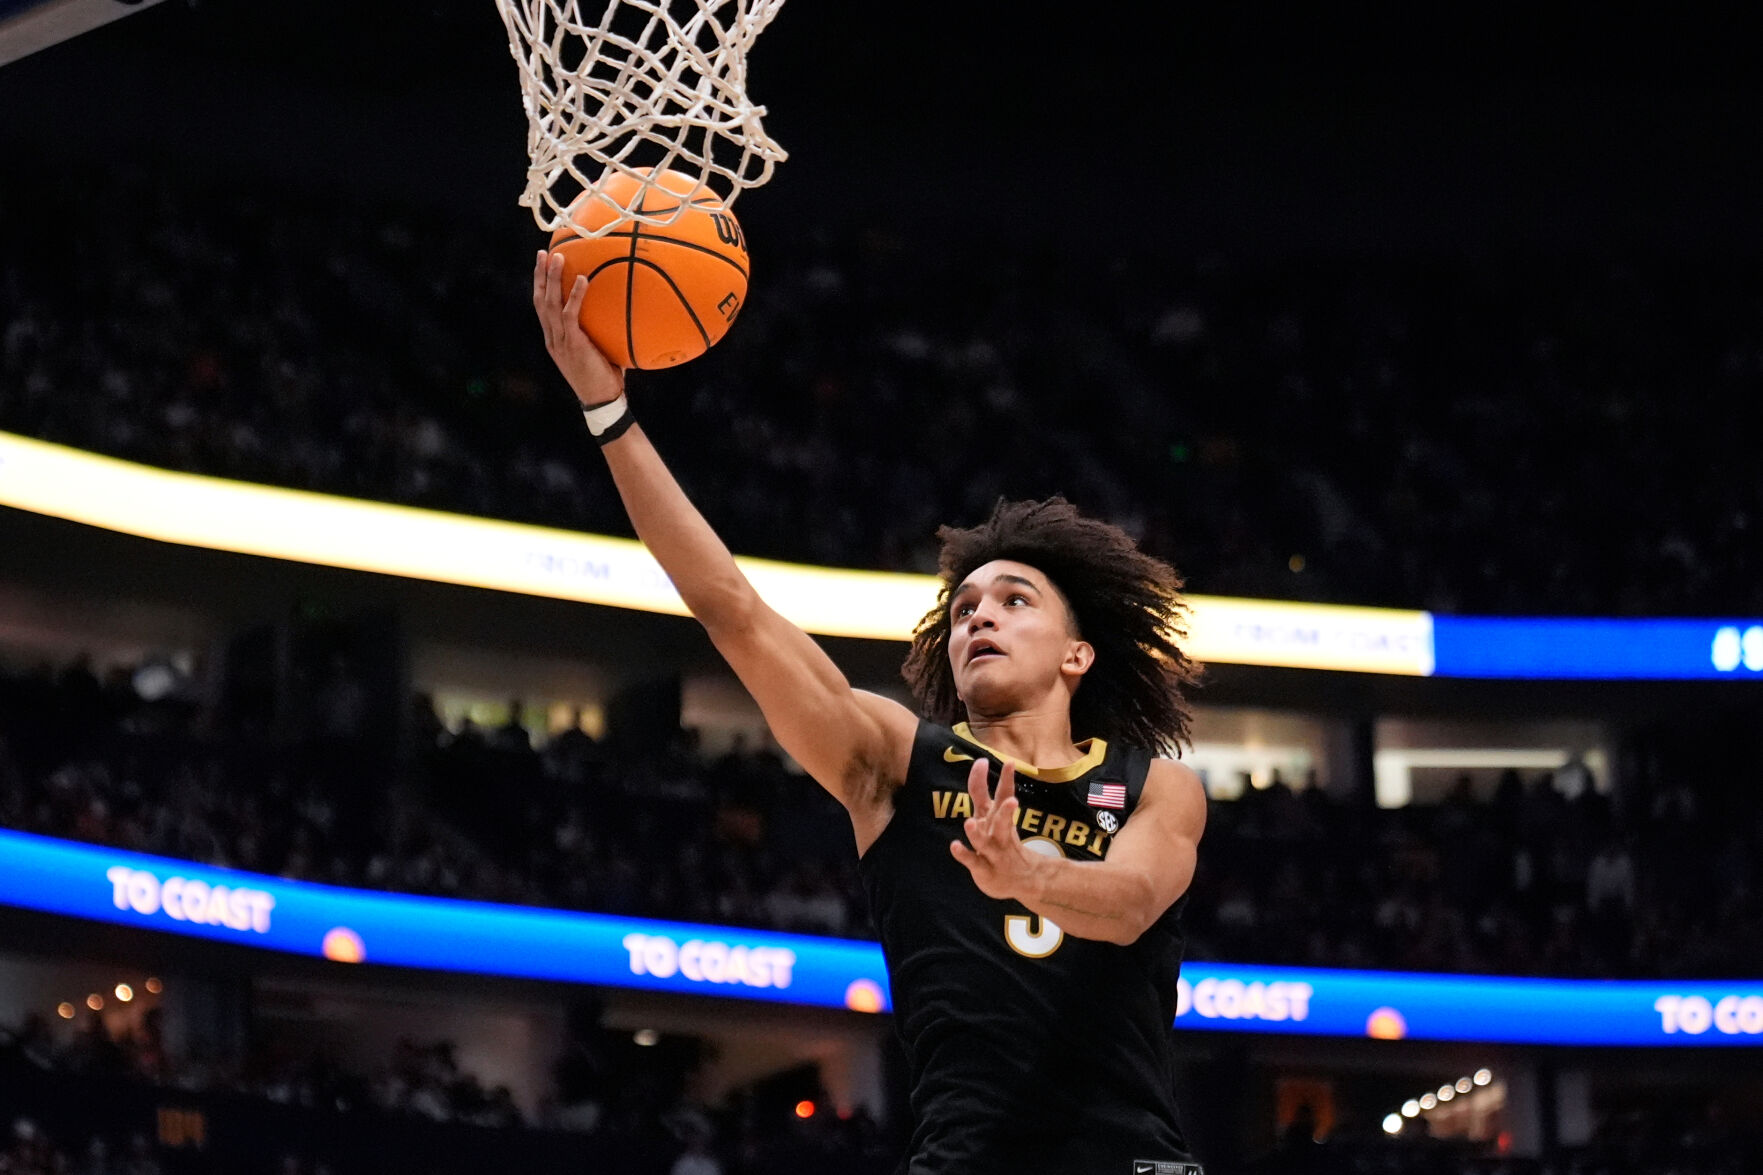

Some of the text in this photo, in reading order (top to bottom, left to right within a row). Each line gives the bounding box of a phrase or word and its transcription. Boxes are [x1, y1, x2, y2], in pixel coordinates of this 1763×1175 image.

[932, 791, 1108, 857] VAERBI
[106, 866, 276, 934] TO COAST
[623, 933, 796, 989] TO COAST
[1193, 977, 1314, 1022] COAST
[1654, 994, 1763, 1034] TO CO
